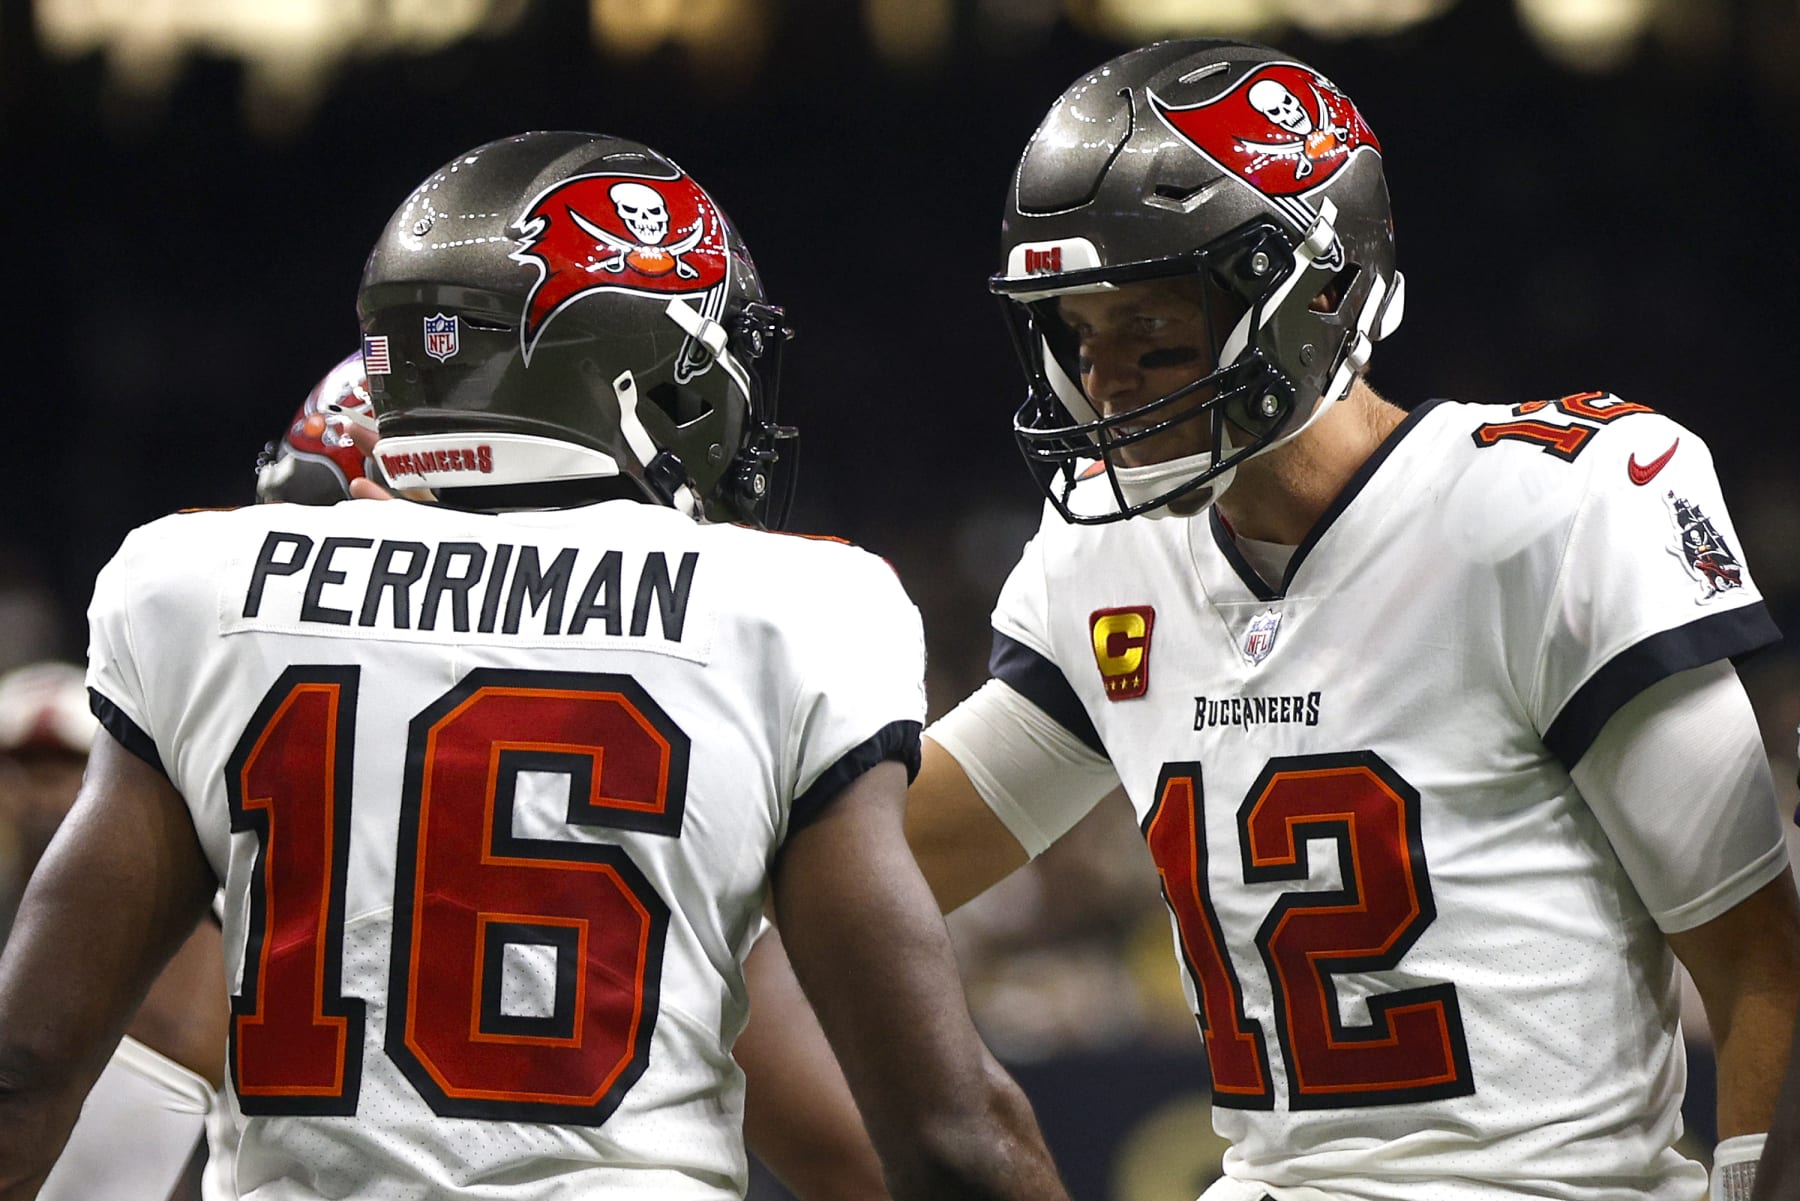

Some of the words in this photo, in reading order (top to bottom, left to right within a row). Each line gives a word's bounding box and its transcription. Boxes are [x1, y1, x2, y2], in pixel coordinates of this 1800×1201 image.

[428, 334, 454, 354] NFL
[381, 445, 493, 481] BUCCANEERS
[242, 531, 699, 643] PERRIMAN
[1093, 613, 1146, 677] C
[1247, 634, 1267, 655] NFL
[1193, 691, 1321, 732] BUCCANEERS
[224, 664, 691, 1127] 16
[1141, 750, 1475, 1111] 12
